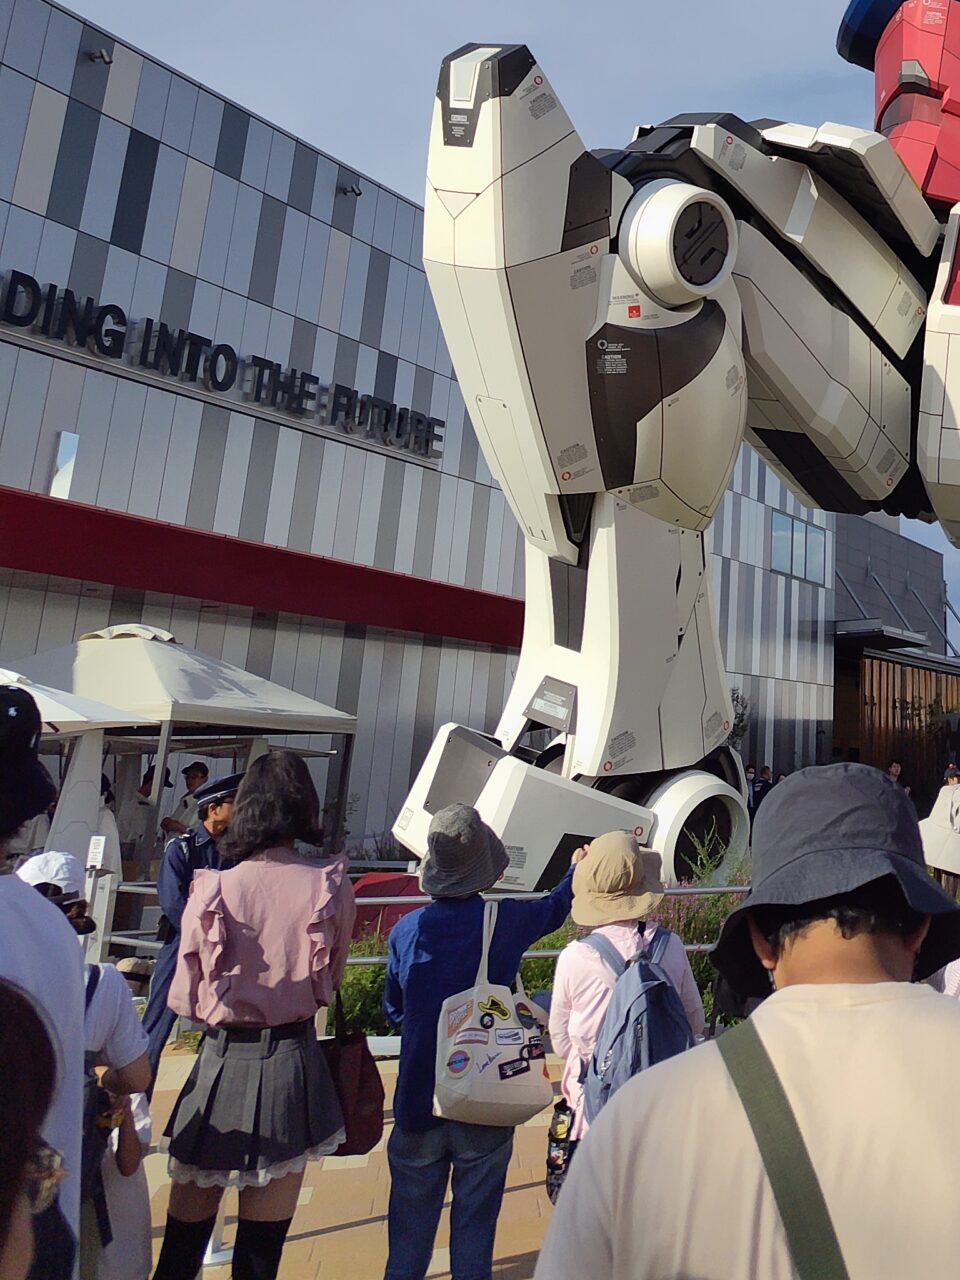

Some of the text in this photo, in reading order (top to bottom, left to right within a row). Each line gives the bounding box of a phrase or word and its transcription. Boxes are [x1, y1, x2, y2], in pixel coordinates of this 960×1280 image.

[3, 269, 446, 459] DING INTO THE FUTURE
